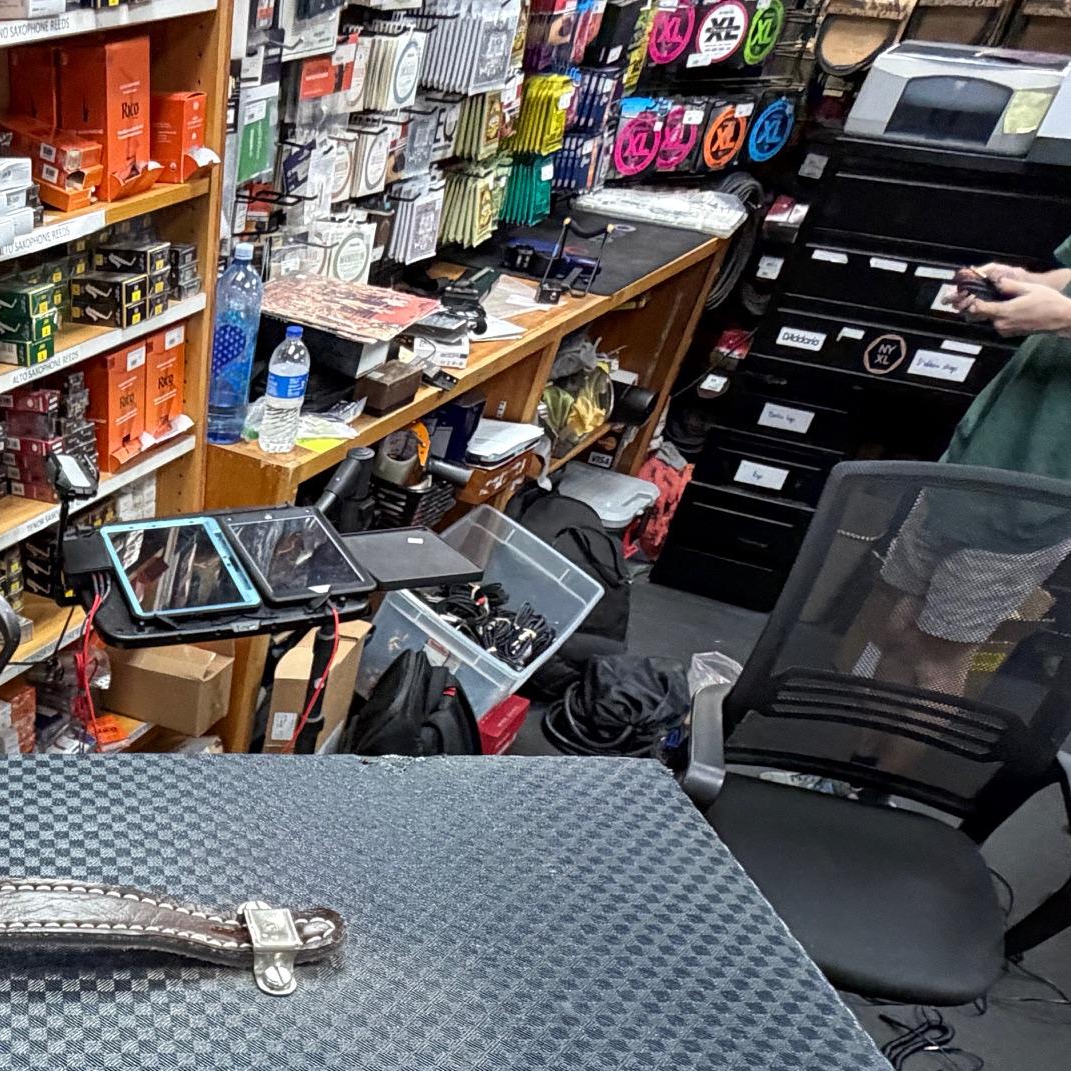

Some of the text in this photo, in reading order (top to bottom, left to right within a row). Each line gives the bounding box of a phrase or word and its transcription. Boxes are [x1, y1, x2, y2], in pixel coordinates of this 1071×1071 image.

[10, 20, 49, 38] SAXOPHONE
[50, 17, 70, 31] REEDS
[704, 17, 741, 42] XL
[15, 231, 51, 252] SAXOPHONE
[52, 226, 70, 239] REEDS
[878, 343, 898, 355] NY
[875, 354, 890, 366] XL
